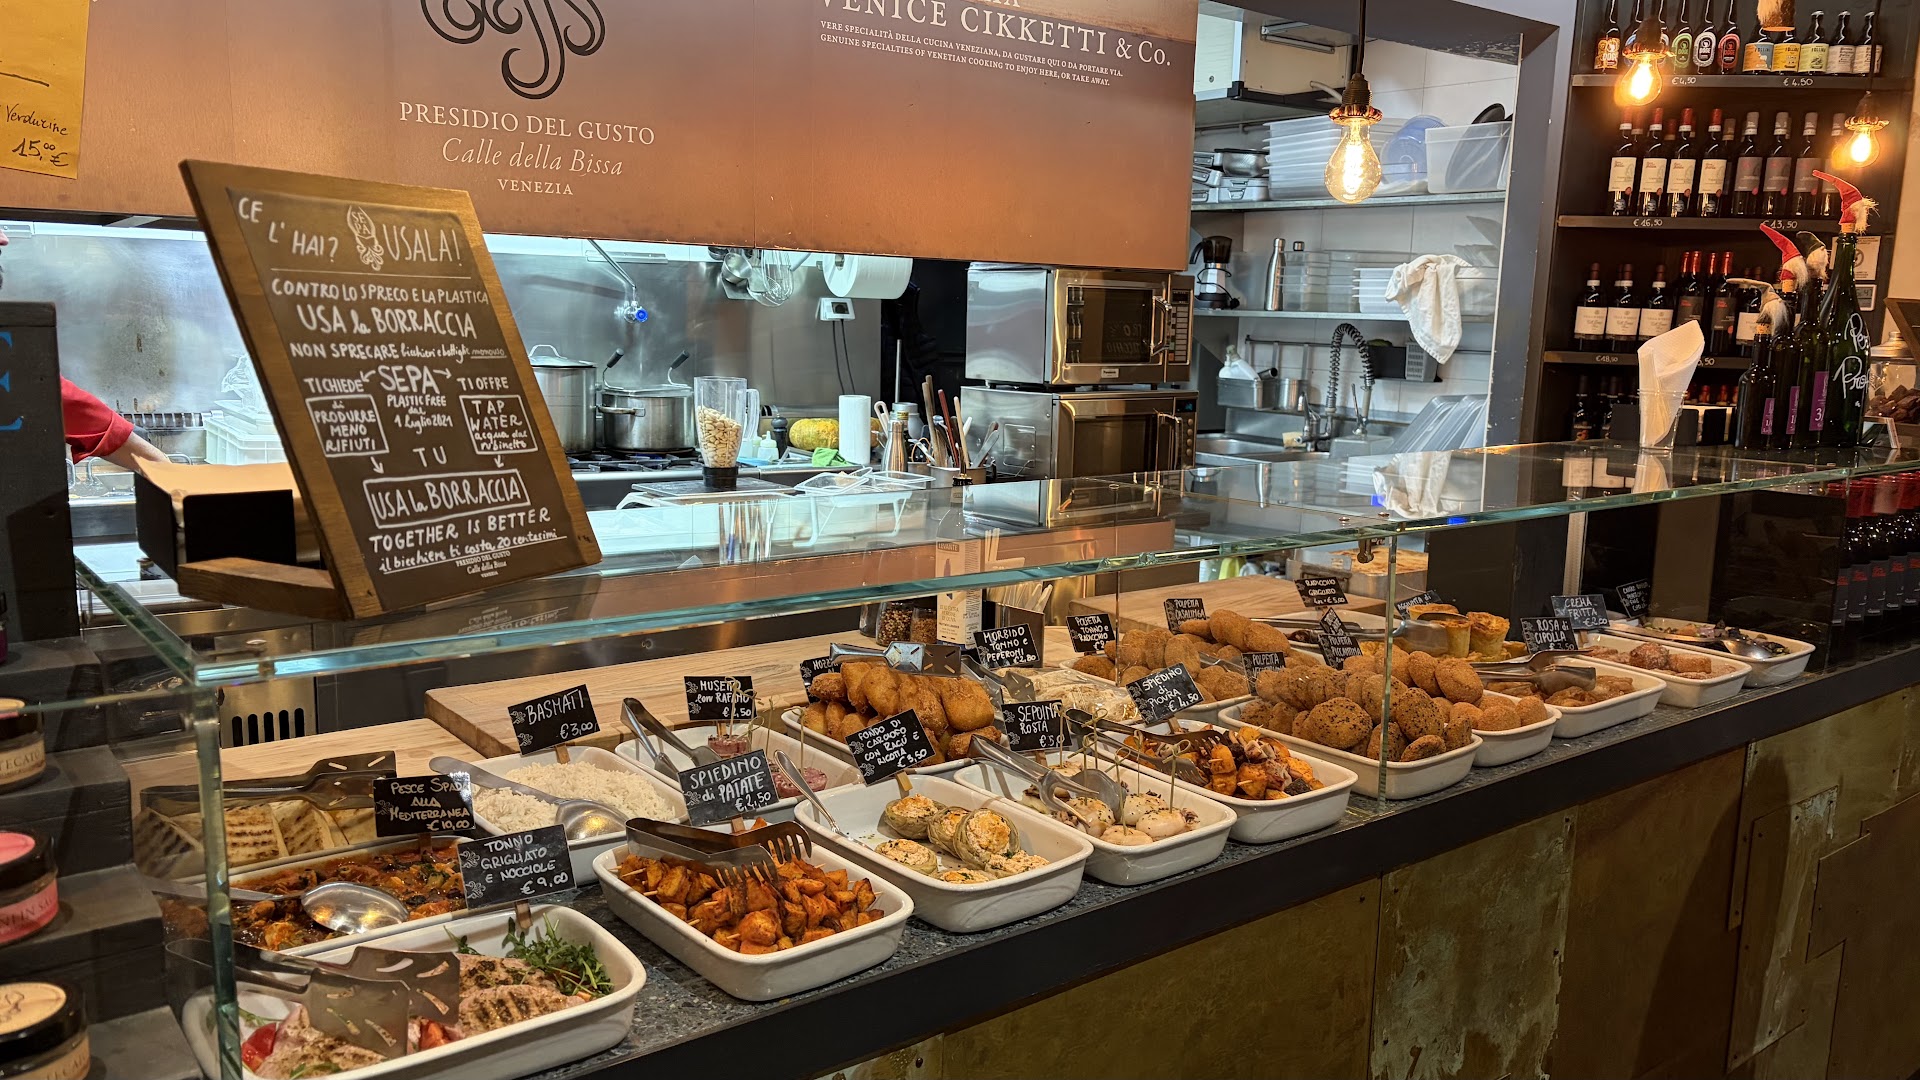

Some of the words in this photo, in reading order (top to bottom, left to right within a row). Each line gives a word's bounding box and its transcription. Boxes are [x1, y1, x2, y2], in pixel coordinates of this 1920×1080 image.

[960, 7, 1107, 55] CIKKETTI
[1115, 36, 1132, 60] &
[1137, 40, 1171, 67] Co.
[820, 20, 843, 32] VERE
[844, 24, 893, 40] SPECIALITÀ
[895, 32, 921, 45] DELLA
[923, 36, 954, 50] CUCINA
[956, 41, 1001, 59] VENEZIANA,
[1002, 49, 1013, 58] DA
[1014, 51, 1045, 65] GUSTARE
[1047, 56, 1060, 67] QUI
[1061, 59, 1067, 68] O
[1068, 60, 1078, 69] DA
[1079, 62, 1108, 75] PORTARE
[1109, 67, 1123, 77] VIA.
[820, 33, 859, 48] GENUINE
[861, 39, 913, 56] SPECIALTIES
[915, 48, 925, 57] OF
[926, 49, 967, 63] VENETIAN
[968, 56, 1003, 70] COOKING
[1005, 61, 1015, 71] TO
[1016, 63, 1039, 76] ENJOY
[1040, 67, 1060, 79] HERE,
[1061, 71, 1071, 80] OR
[1072, 73, 1090, 83] TAKE
[1090, 76, 1110, 87] AWAY.
[6, 103, 68, 135] Verdurine
[399, 101, 518, 131] PRESIDIO
[526, 115, 572, 137] DEL
[578, 121, 654, 145] GUSTO
[50, 152, 69, 167] €
[442, 137, 502, 166] Calle
[509, 141, 562, 171] della
[569, 148, 623, 177] Bissa
[497, 178, 573, 195] VENEZIA
[238, 197, 263, 223] CE
[268, 221, 285, 243] L'
[292, 230, 338, 263] HAI?
[382, 224, 462, 267] USALA!
[271, 278, 339, 300] CONTRO
[342, 285, 358, 301] LO
[360, 284, 408, 302] SPRECO
[412, 287, 418, 301] E
[437, 288, 489, 305] PLASTICA
[296, 304, 347, 334] USA
[371, 307, 477, 339] BORRACCIA
[290, 341, 327, 359] NON
[330, 343, 398, 361] SPRECARE
[400, 341, 435, 358] bicchieri
[378, 365, 440, 394] SEPA
[476, 377, 509, 391] OFFRE
[386, 394, 423, 408] PLASTIC
[425, 394, 447, 407] FREE
[313, 410, 376, 424] PRODURRE
[470, 415, 522, 432] WATER
[329, 424, 367, 437] MENO
[325, 439, 376, 452] RIFIUTI
[480, 440, 527, 451] rubinetto
[371, 485, 410, 520] USA
[425, 477, 521, 510] BORRACCIA
[369, 523, 459, 554] TOGETHER
[467, 519, 481, 535] IS
[488, 507, 551, 532] BETTER
[463, 540, 496, 555] costa
[497, 537, 511, 548] 20
[1565, 597, 1592, 608] CREMA
[1568, 607, 1598, 619] FRITTA
[1537, 618, 1559, 632] ROSA
[1561, 621, 1569, 630] di
[982, 626, 1026, 643] MORBIDO
[1534, 631, 1567, 644] CIPOLLA
[989, 640, 1020, 652] TONNO
[986, 648, 1024, 662] PEPERONI
[1252, 653, 1279, 666] POLPETTA
[1142, 667, 1183, 691] SPIEDINO
[1147, 688, 1182, 709] PIOVRA
[1158, 685, 1168, 695] di
[524, 689, 585, 726] BASMATI
[1178, 693, 1199, 708] 4,50
[858, 726, 886, 741] FONDO
[890, 719, 901, 728] DI
[1019, 720, 1049, 735] ROSTA
[864, 749, 881, 762] CON
[877, 747, 907, 766] RICOTTA
[690, 756, 762, 789] SPIEDINO
[390, 782, 425, 795] PESCE
[702, 788, 716, 801] di
[718, 770, 765, 803] PATATE
[410, 796, 442, 808] ALLA
[389, 806, 470, 821] MEDITERRANEA
[484, 834, 534, 853] TONNO
[480, 847, 547, 870] GRIGLIATO
[485, 872, 493, 883] E
[500, 860, 556, 882] NOCCIOLE
[537, 872, 568, 889] 9,00
